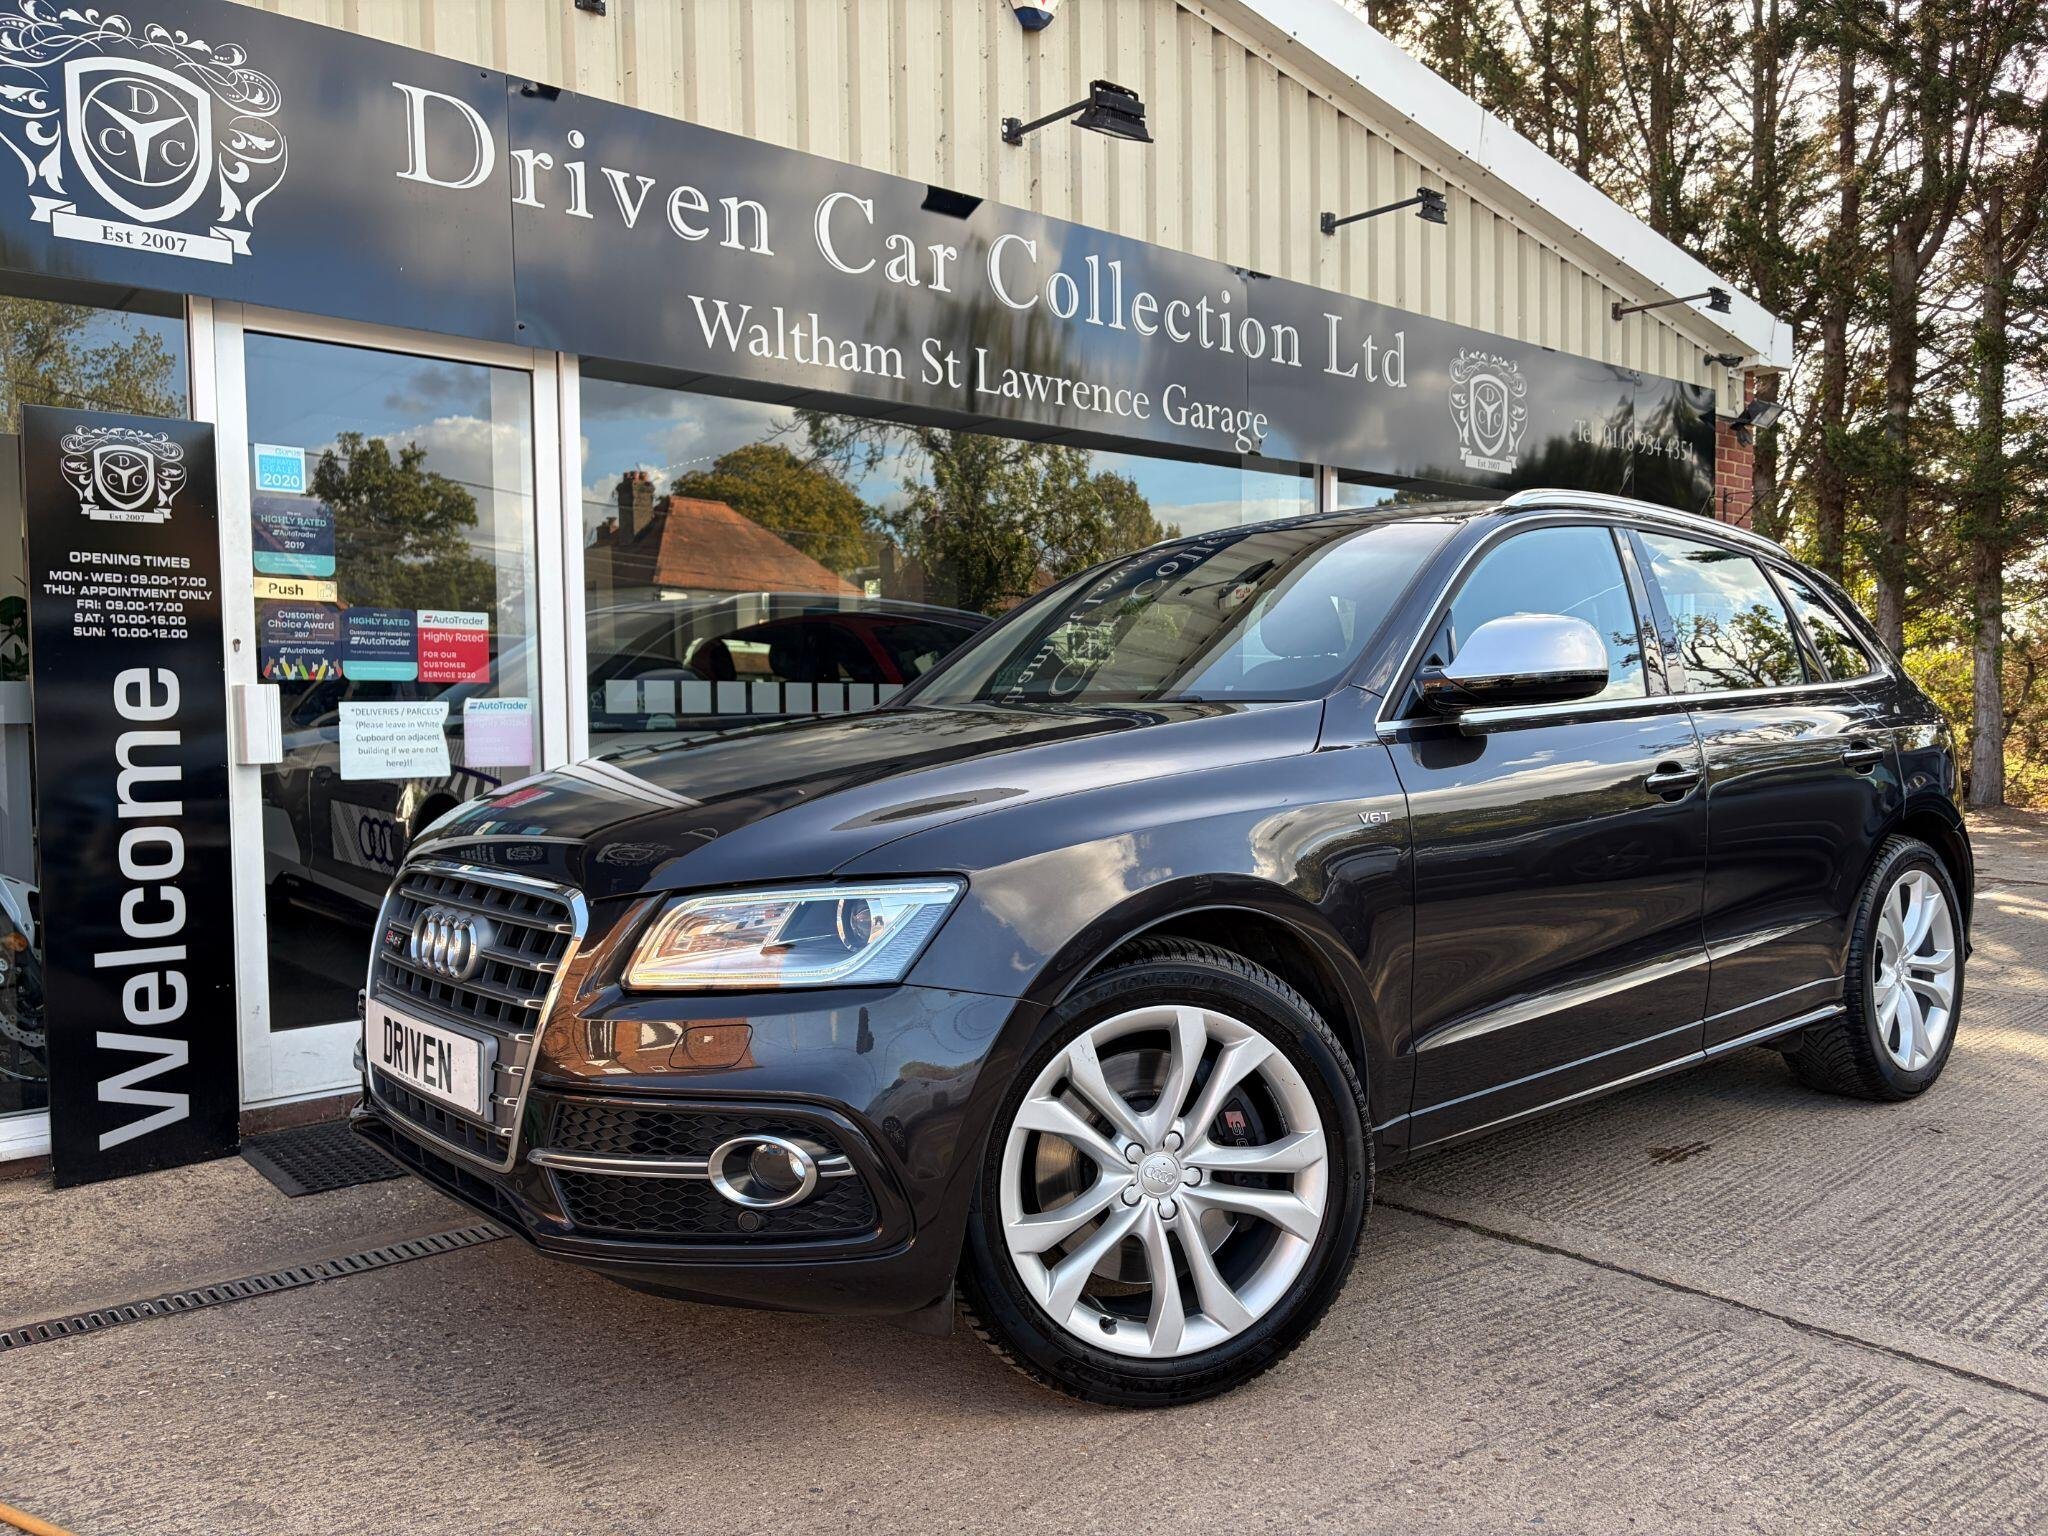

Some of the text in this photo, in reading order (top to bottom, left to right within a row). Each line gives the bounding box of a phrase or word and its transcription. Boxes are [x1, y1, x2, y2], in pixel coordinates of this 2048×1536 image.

[127, 85, 159, 115] D
[99, 127, 187, 167] C C
[101, 224, 187, 253] Est 2007
[392, 81, 1407, 389] Driven Car Collection Ltd
[688, 294, 1269, 453] Waltham St Lawrence Garage
[1603, 424, 1634, 452] 0118
[1639, 431, 1662, 456] 934
[1664, 437, 1693, 461] 4351
[119, 456, 130, 467] D
[107, 473, 143, 487] C C
[263, 472, 300, 488] 2020
[109, 513, 145, 522] Est 2007
[260, 514, 295, 525] HIGHLY
[297, 516, 327, 528] RATED
[279, 529, 317, 539] AutoTrader
[284, 540, 306, 550] 2019
[69, 551, 191, 569] OPENING TIMES
[130, 573, 207, 587] 09.00-17.00
[43, 583, 213, 601] THU: APPOINTMENT ONLY
[268, 582, 304, 597] Push
[77, 599, 184, 612] FRI: 09.00-17.00
[74, 613, 187, 626] SAT: 10.00-16.00
[277, 609, 325, 621] Customer
[432, 615, 485, 626] AutoTrader
[267, 619, 335, 630] Choice Award
[349, 616, 411, 627] HIGHLY RATED
[73, 627, 188, 639] SUN: 10.00-12.00
[294, 631, 310, 639] 2017
[423, 631, 484, 644] Highly Rated
[359, 636, 411, 647] AutoTrader
[286, 647, 325, 655] AutoTrader
[423, 650, 457, 659] FOR OUR
[423, 660, 466, 669] CUSTOMER
[423, 671, 456, 679] SERVICE
[477, 700, 528, 711] AutoTrader
[385, 721, 406, 729] leave
[408, 720, 416, 728] in
[416, 720, 440, 728] White
[355, 733, 394, 744] Cupboard
[407, 732, 440, 743] adjacent
[357, 746, 390, 756] building
[425, 746, 439, 754] not
[1358, 811, 1391, 824] V6T
[94, 667, 190, 1152] Welcome
[383, 1015, 452, 1094] DRIVEN
